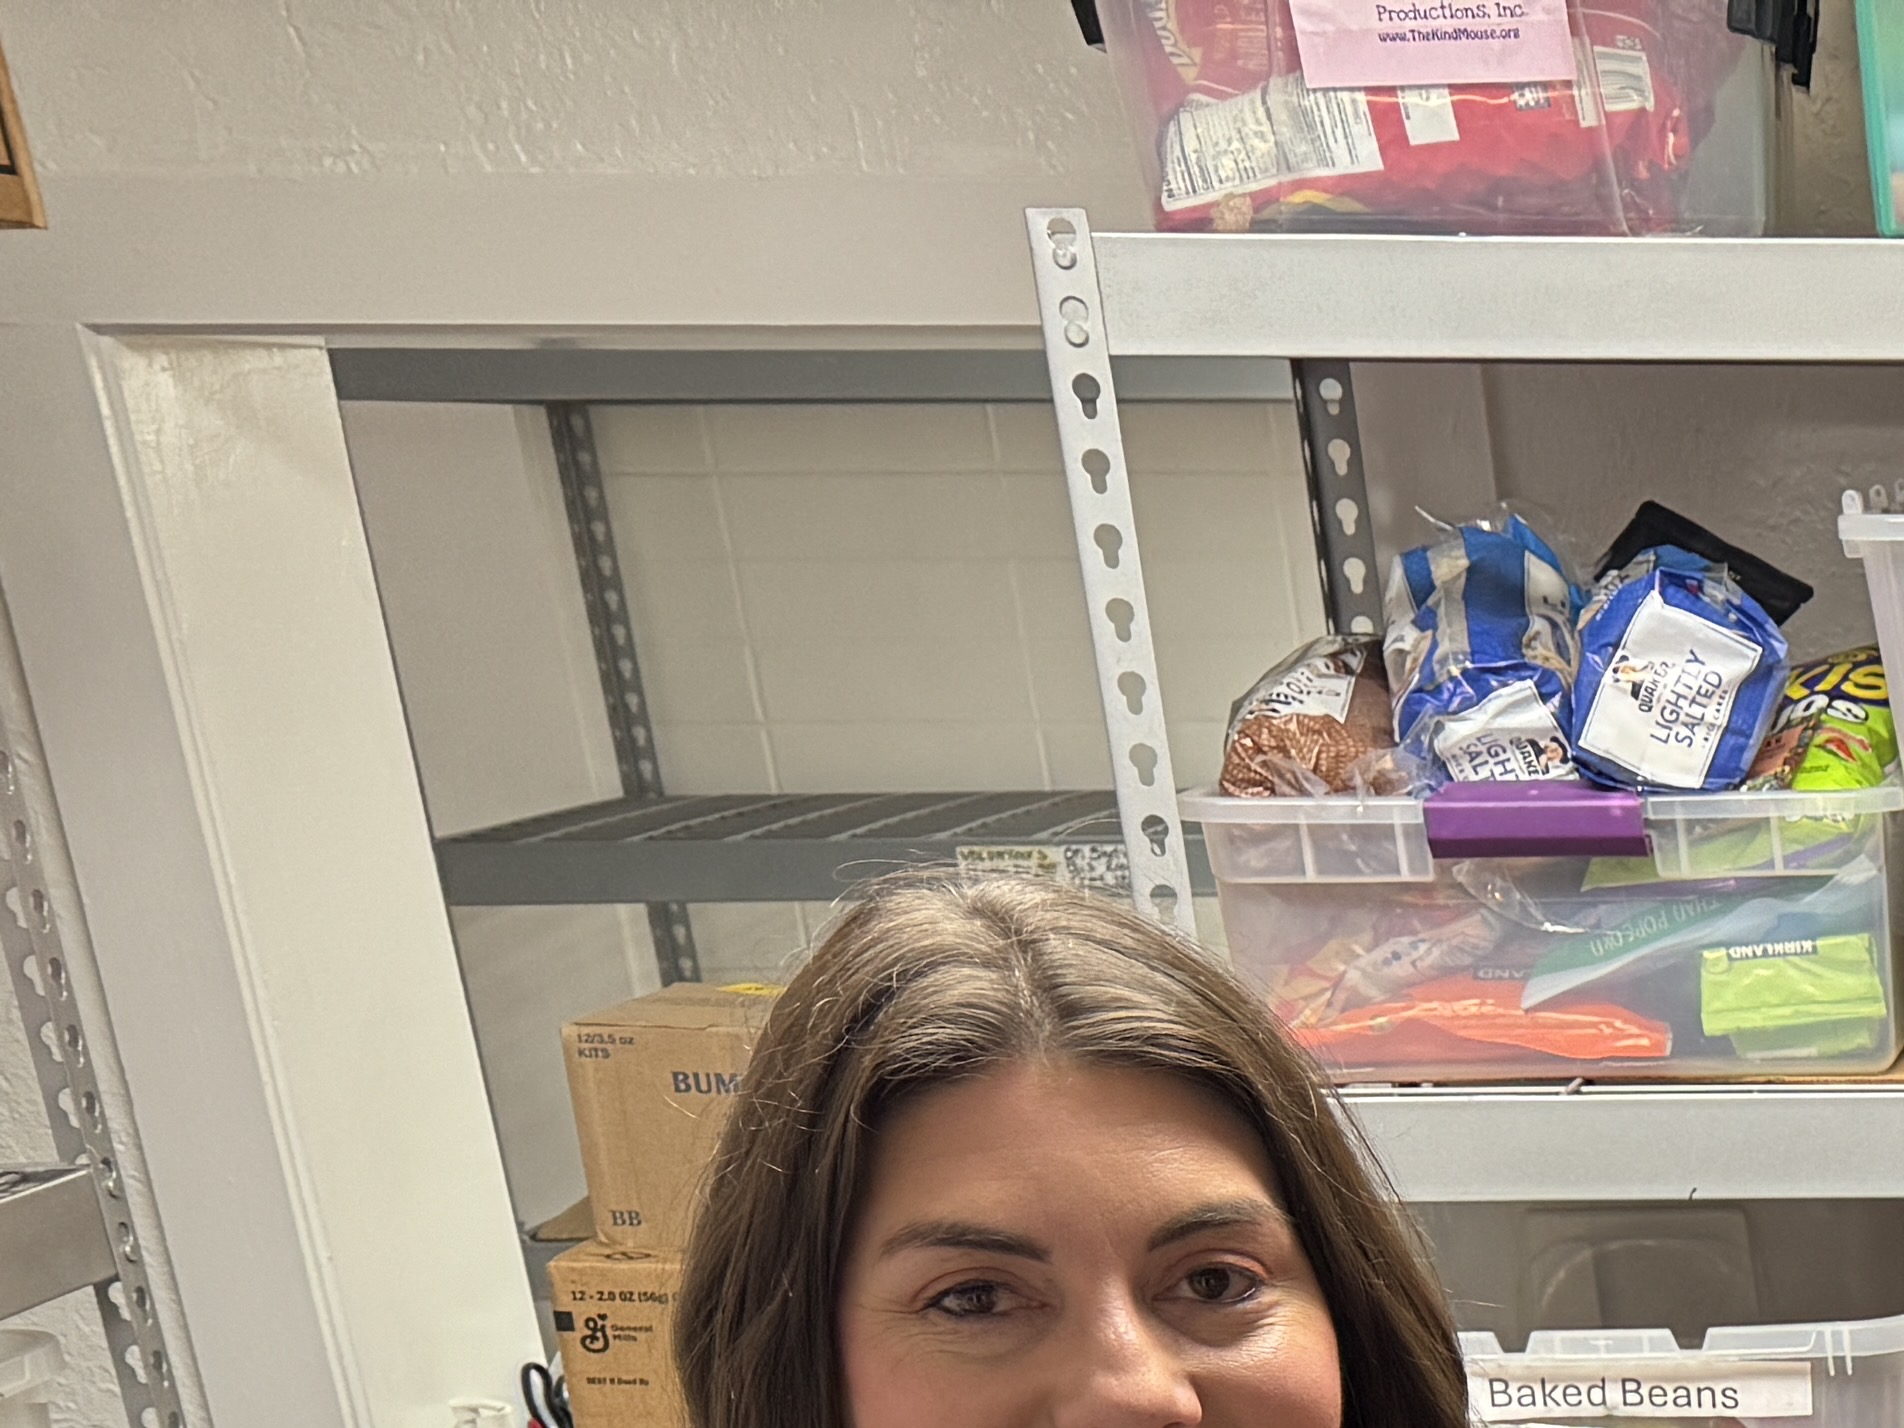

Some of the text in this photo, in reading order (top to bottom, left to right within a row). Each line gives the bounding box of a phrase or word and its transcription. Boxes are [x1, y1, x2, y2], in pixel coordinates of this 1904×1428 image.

[1650, 649, 1706, 744] LIGHTLY
[1674, 670, 1723, 748] SALTED
[1729, 940, 1812, 957] KIRKLAND
[610, 1209, 642, 1226] BB
[1488, 1377, 1740, 1411] Baked Beans
